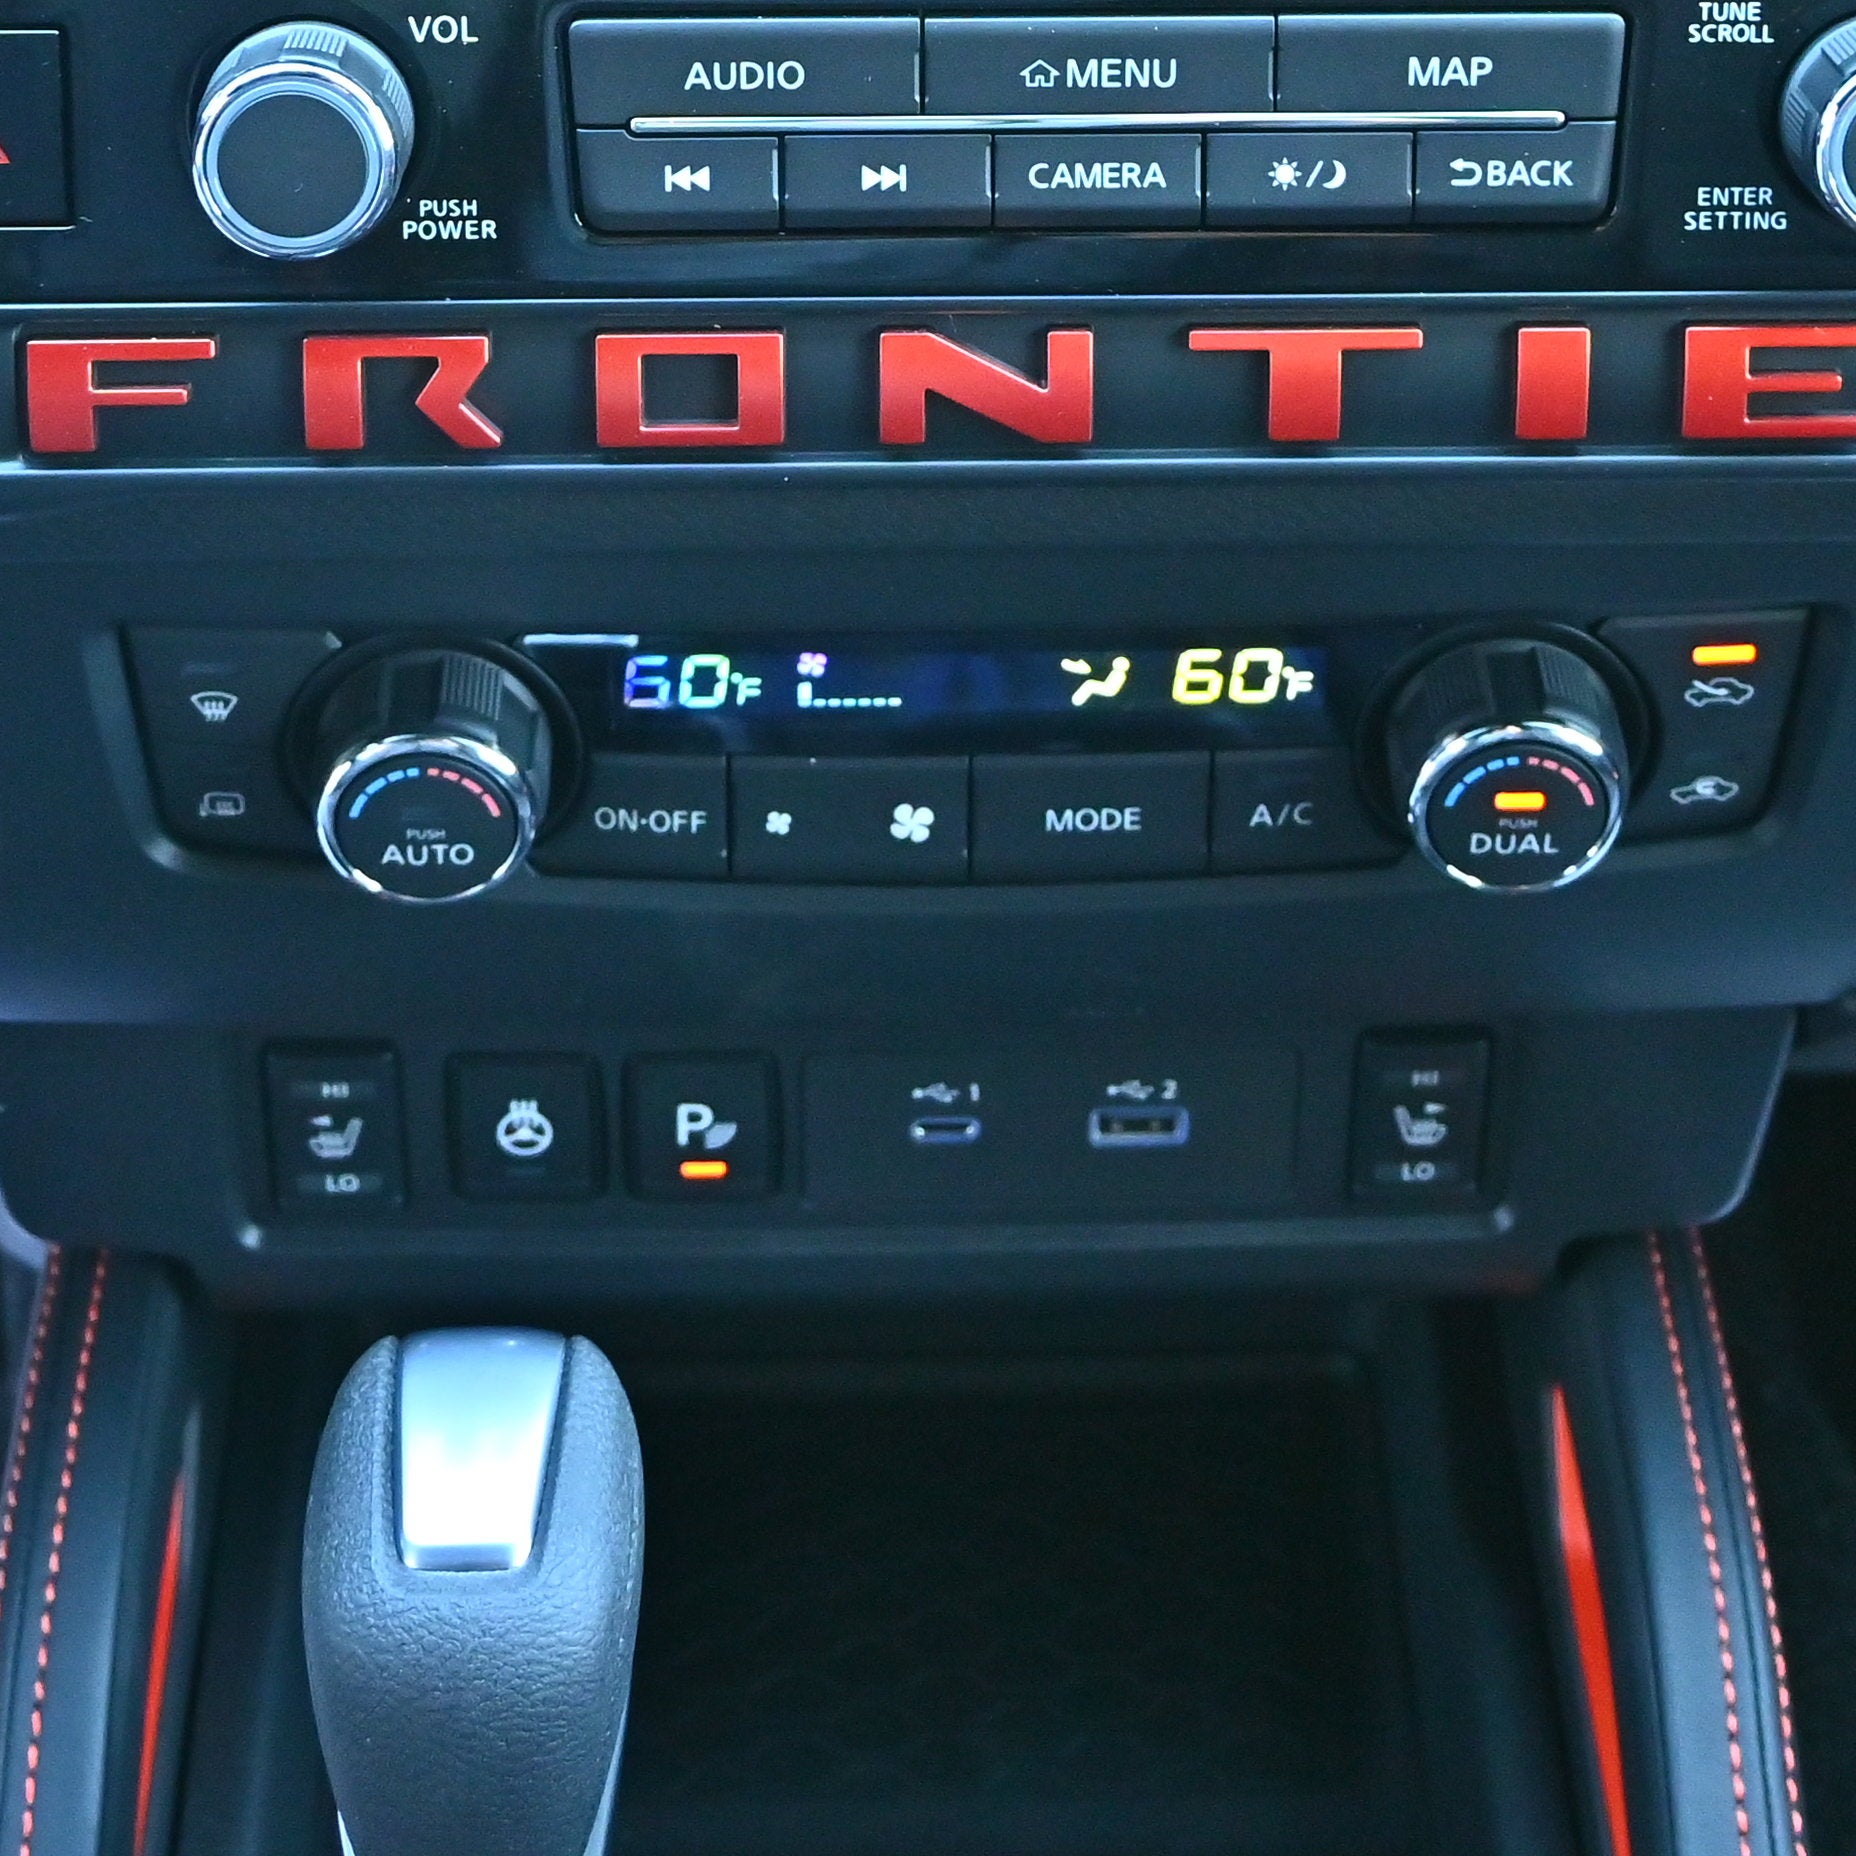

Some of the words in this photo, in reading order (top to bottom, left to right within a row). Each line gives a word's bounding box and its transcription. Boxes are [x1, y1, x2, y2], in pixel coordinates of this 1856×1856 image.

[1698, 1, 1762, 23] TUNE
[407, 14, 479, 46] VOL
[1687, 23, 1775, 44] SCROLL
[683, 60, 805, 91] AUDIO
[1066, 58, 1177, 89] MENU
[1407, 56, 1494, 87] MAP
[1028, 161, 1168, 190] CAMERA
[1486, 159, 1574, 187] BACK
[1696, 186, 1773, 208] ENTER
[418, 199, 479, 219] PUSH
[402, 219, 498, 241] POWER
[1683, 210, 1787, 232] SETTING
[1045, 806, 1142, 833] MODE
[1248, 802, 1311, 828] A/C
[381, 843, 475, 867] AUTO
[1469, 832, 1559, 855] DUAL
[1401, 1160, 1436, 1181] LO
[325, 1173, 361, 1193] LO
